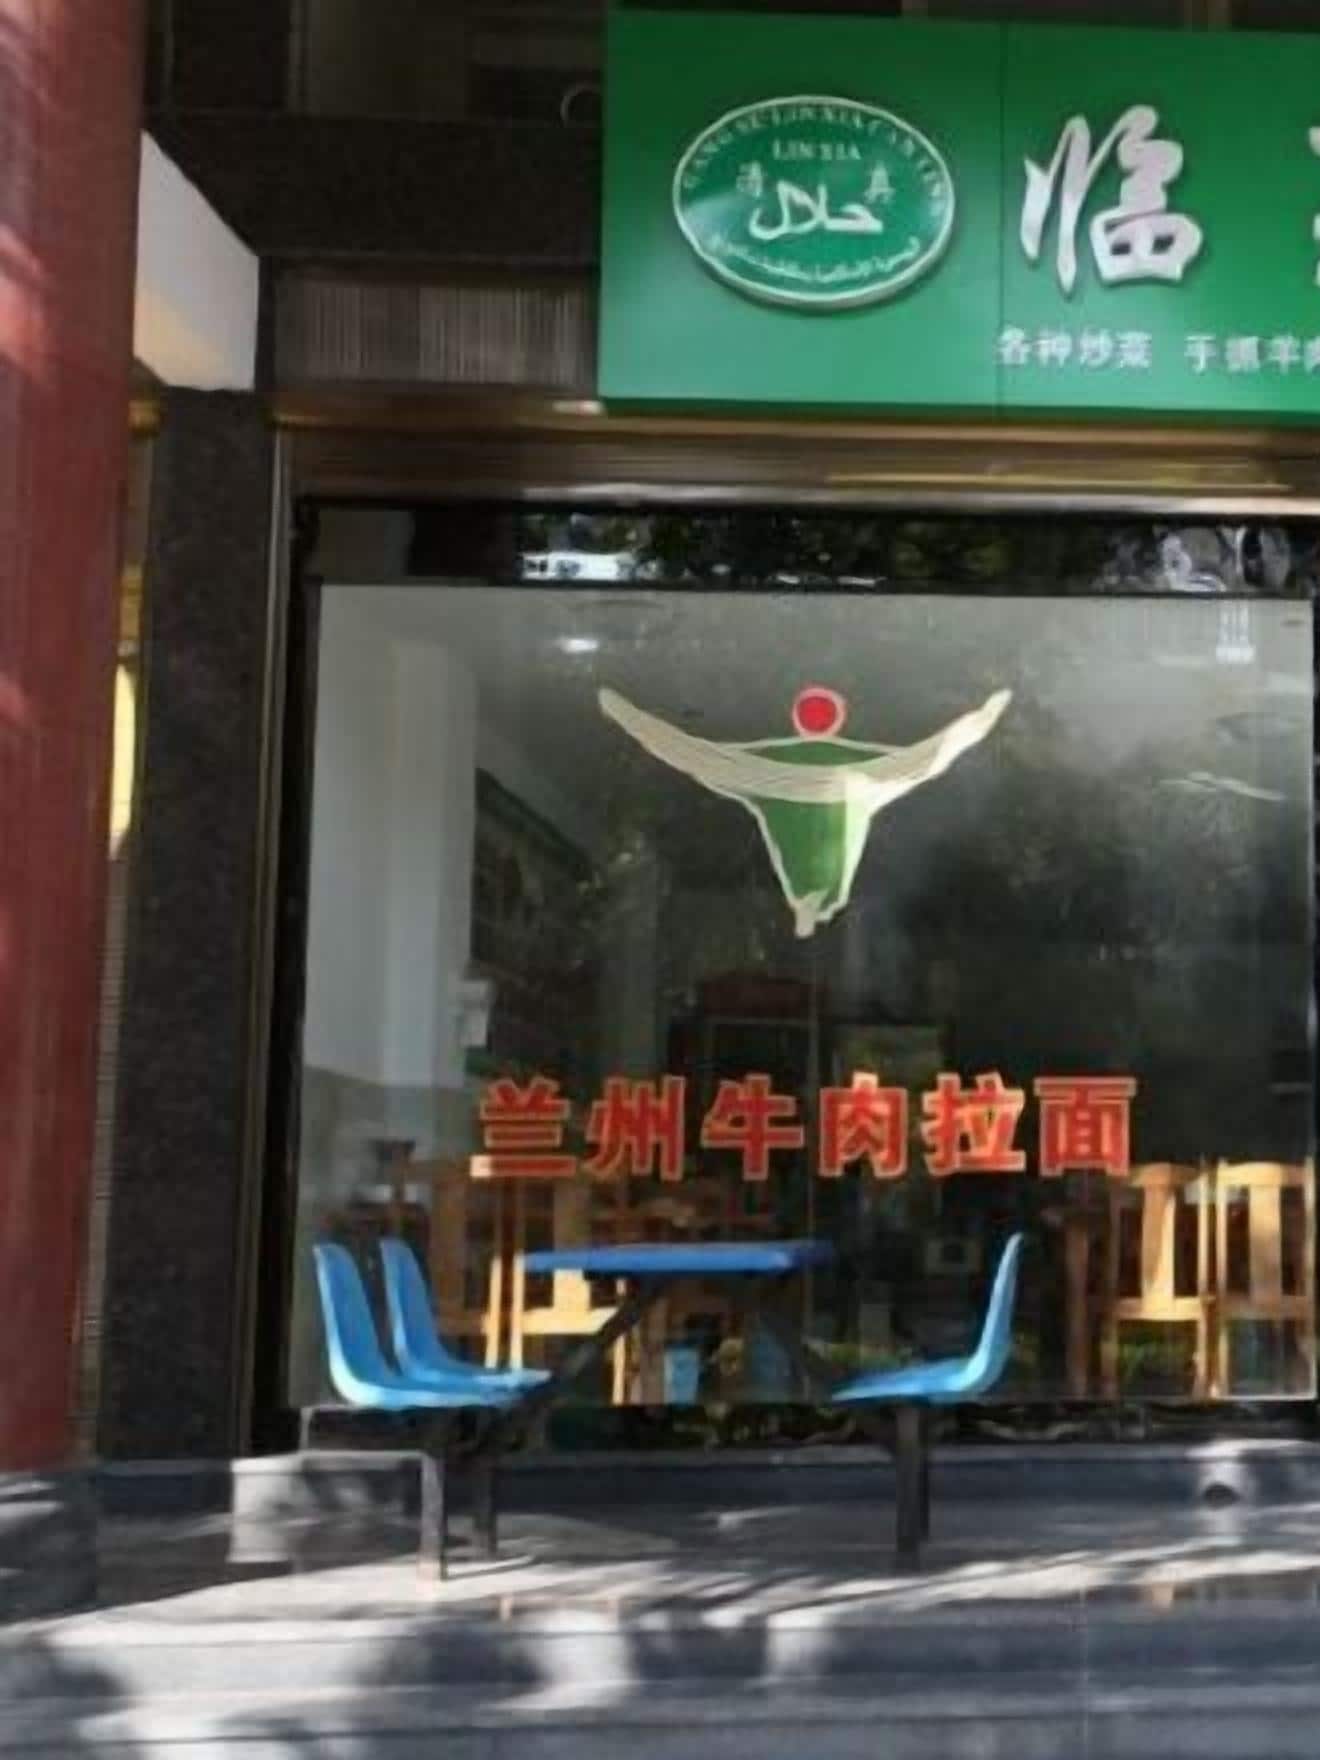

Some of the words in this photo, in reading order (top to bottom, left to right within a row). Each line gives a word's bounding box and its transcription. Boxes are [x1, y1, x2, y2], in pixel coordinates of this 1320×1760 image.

[470, 1073, 1137, 1181] 兰州牛肉拉面
